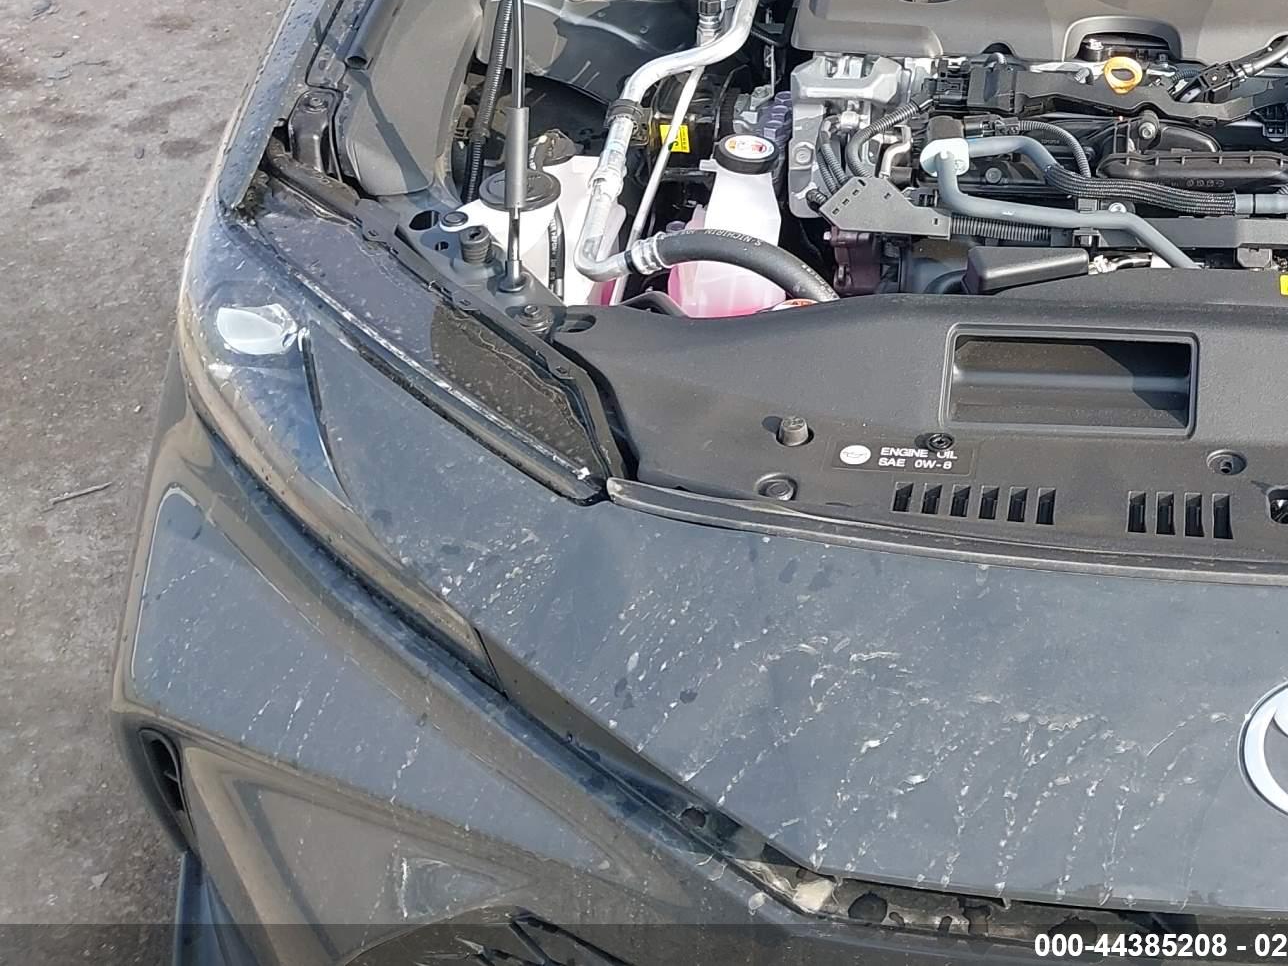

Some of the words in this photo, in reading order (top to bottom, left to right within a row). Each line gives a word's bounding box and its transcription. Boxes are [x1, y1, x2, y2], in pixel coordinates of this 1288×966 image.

[880, 446, 929, 458] ENGINE
[936, 449, 958, 459] OIL
[878, 457, 906, 467] SAE
[914, 459, 953, 470] 0W-8
